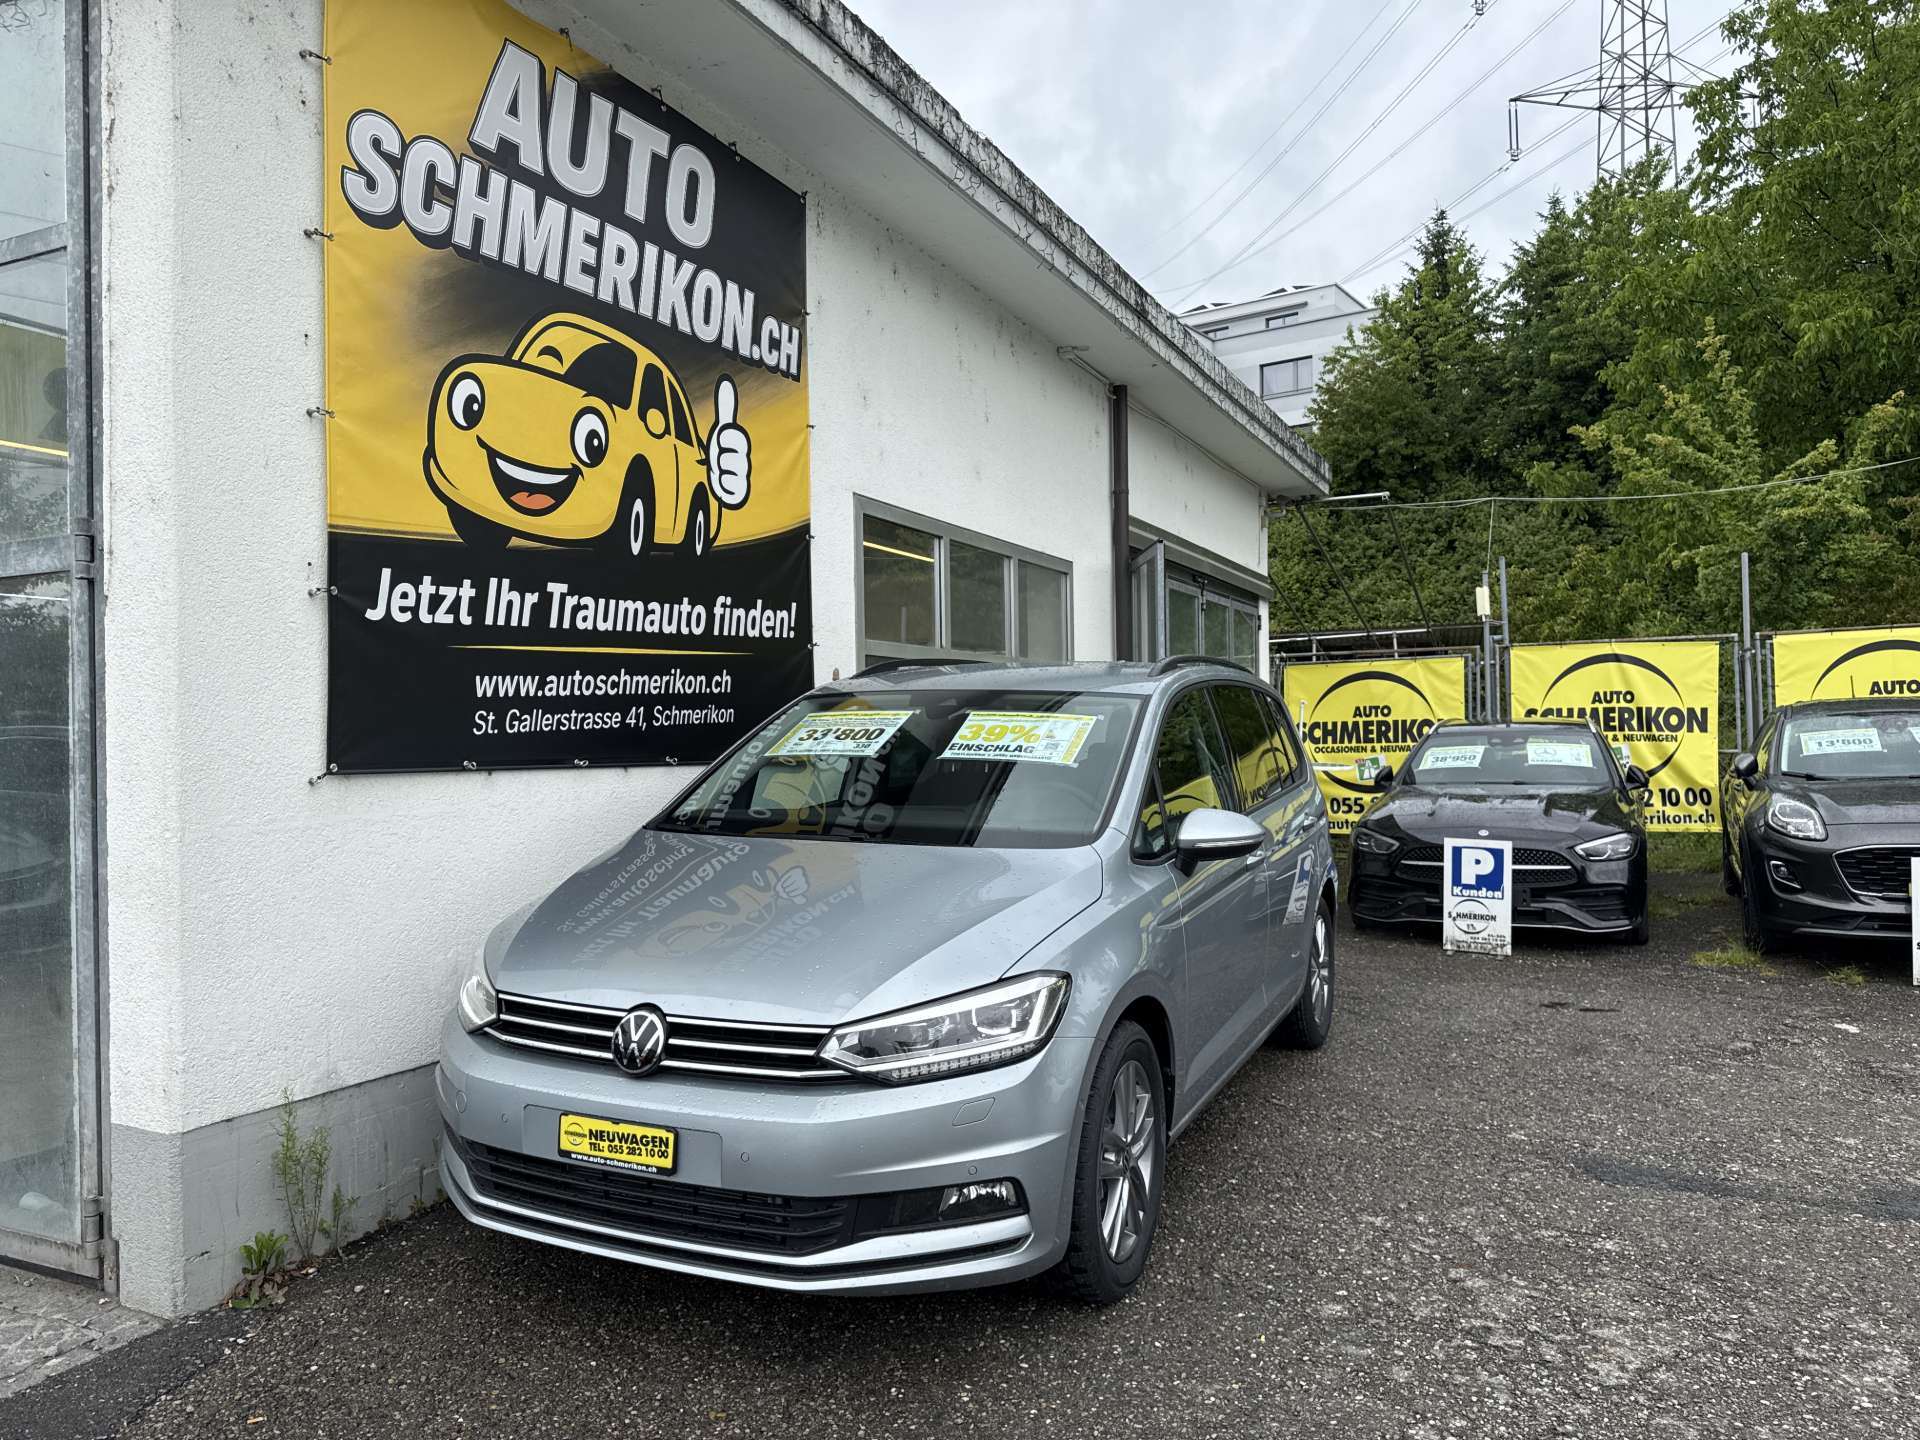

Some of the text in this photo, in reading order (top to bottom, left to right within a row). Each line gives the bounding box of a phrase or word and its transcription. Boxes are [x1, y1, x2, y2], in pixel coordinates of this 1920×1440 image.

[469, 39, 717, 249] AUTO
[342, 110, 801, 379] SCHMERIKON.CH
[365, 567, 797, 639] Jetzt Ihr Traumauto finden!
[475, 669, 732, 698] www.autoschmerikon.ch
[1591, 690, 1635, 705] AUTO
[472, 705, 735, 735] St. Gallerstrasse 41, Schmerikon
[1353, 705, 1391, 719] AUTO
[798, 727, 887, 742] 33'800
[958, 723, 1042, 744] 39%
[1296, 718, 1445, 745] SCHMERIKO
[1611, 733, 1678, 743] & NEUWAGEN
[948, 742, 1036, 754] EINSCHLAG
[1314, 745, 1367, 754] OCCASIONEN
[1370, 745, 1377, 753] &
[1431, 753, 1476, 764] 38'950
[1330, 796, 1365, 815] 055
[1658, 787, 1681, 807] 10
[1684, 787, 1713, 807] 00
[1461, 847, 1495, 885] P
[1453, 886, 1503, 899] Kunden
[588, 1128, 670, 1150] NEUWAGEN
[589, 1142, 669, 1159] TEL: 055 282 10 00
[571, 1152, 657, 1173] www.auto-schmerikon.ch
